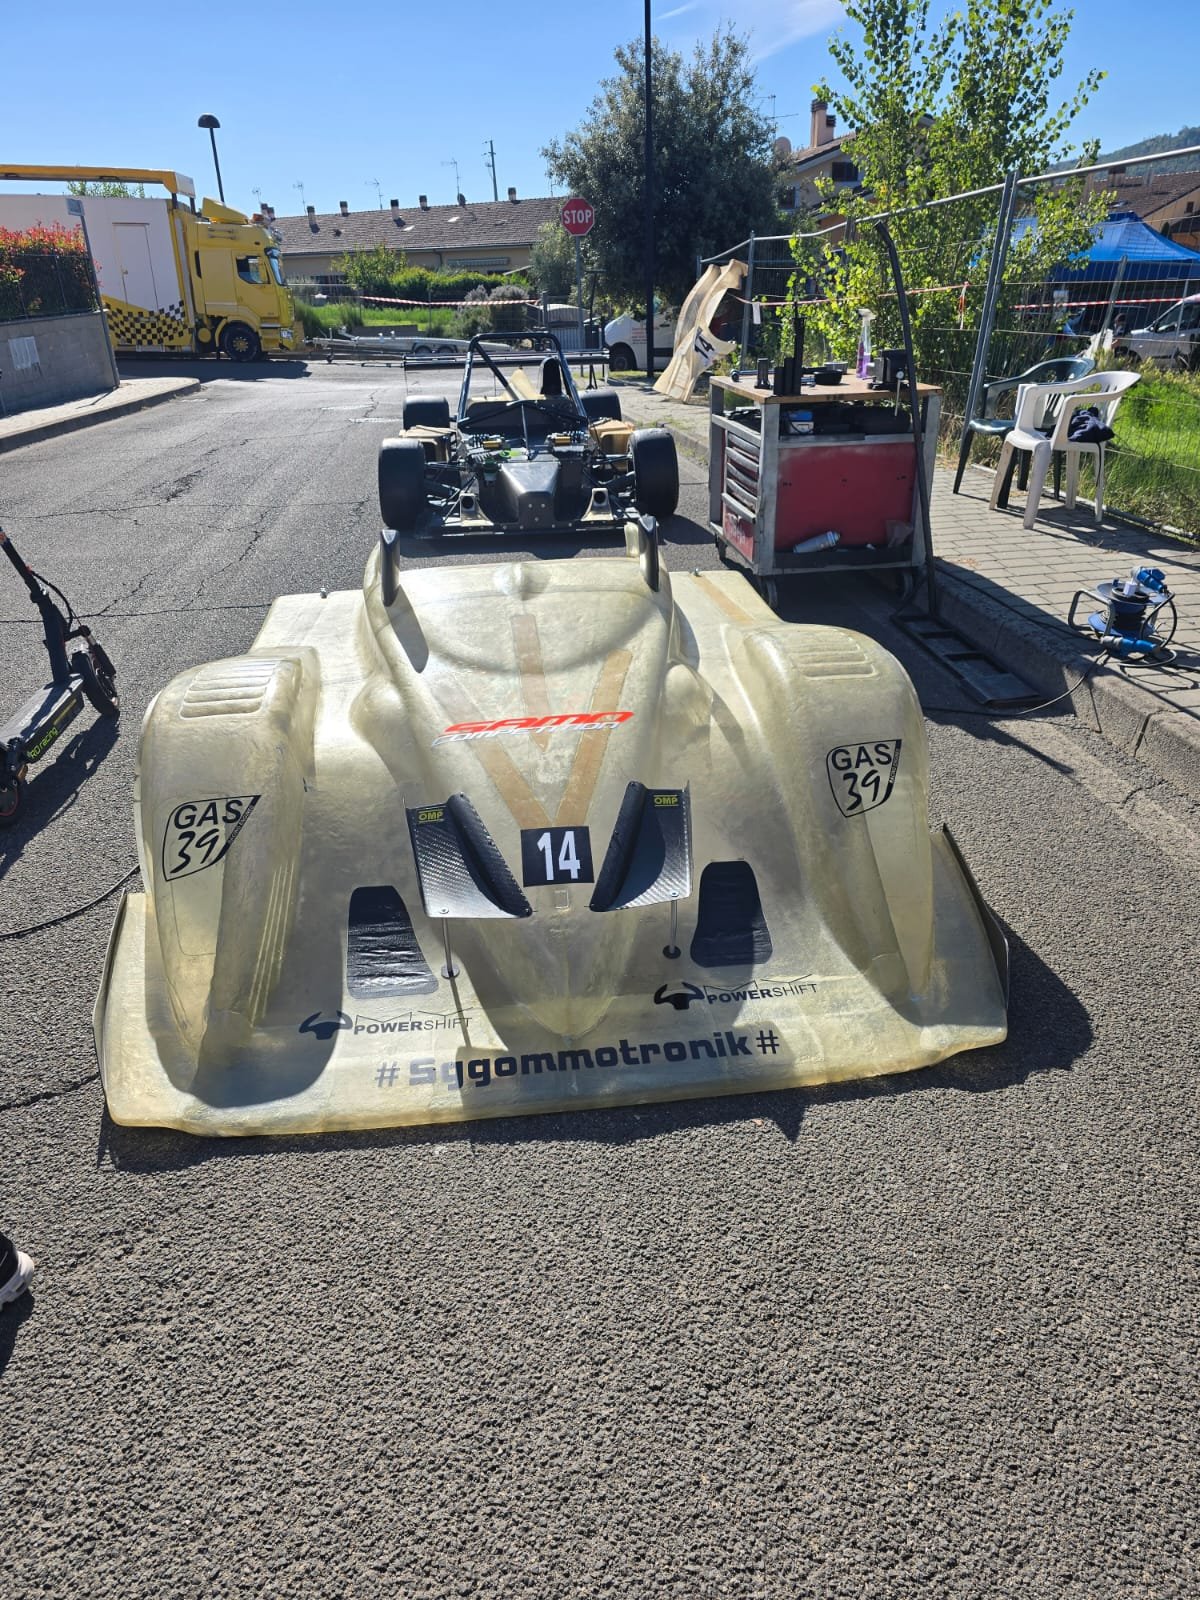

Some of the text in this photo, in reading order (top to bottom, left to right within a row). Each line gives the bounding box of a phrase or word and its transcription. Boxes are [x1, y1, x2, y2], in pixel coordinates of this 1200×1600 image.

[563, 209, 592, 224] STOP
[831, 743, 892, 771] GAS
[655, 795, 679, 805] OMP
[843, 769, 880, 811] 39
[174, 800, 243, 829] GAS
[418, 810, 444, 822] OMP
[169, 828, 220, 874] 39
[537, 830, 581, 880] 14
[706, 983, 817, 1004] POWERSHIFT
[354, 1017, 473, 1035] POWERSHIFT
